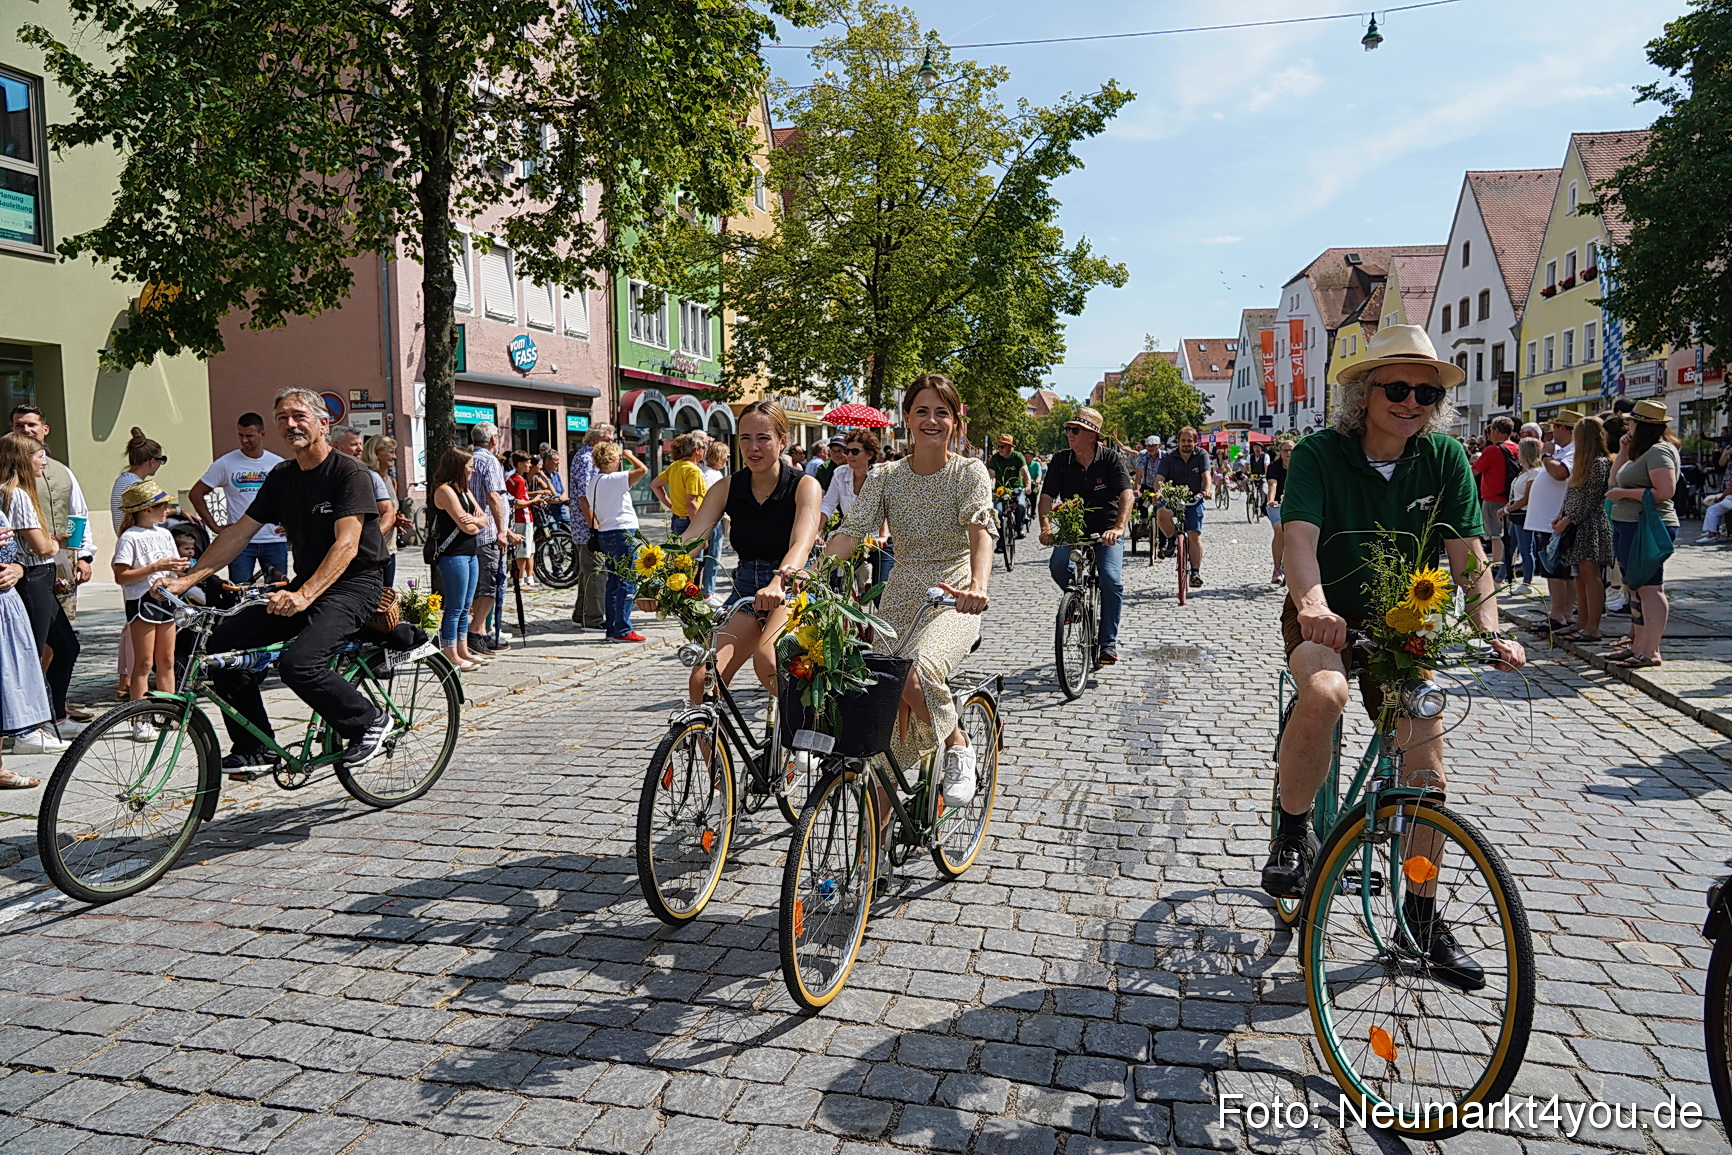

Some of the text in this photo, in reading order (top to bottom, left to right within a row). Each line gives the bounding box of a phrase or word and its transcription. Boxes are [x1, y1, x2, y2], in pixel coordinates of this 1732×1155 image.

[515, 347, 538, 367] FASS
[1291, 342, 1304, 376] SALE
[351, 402, 384, 410] Bockwirtsgasse
[475, 410, 494, 422] Whisky
